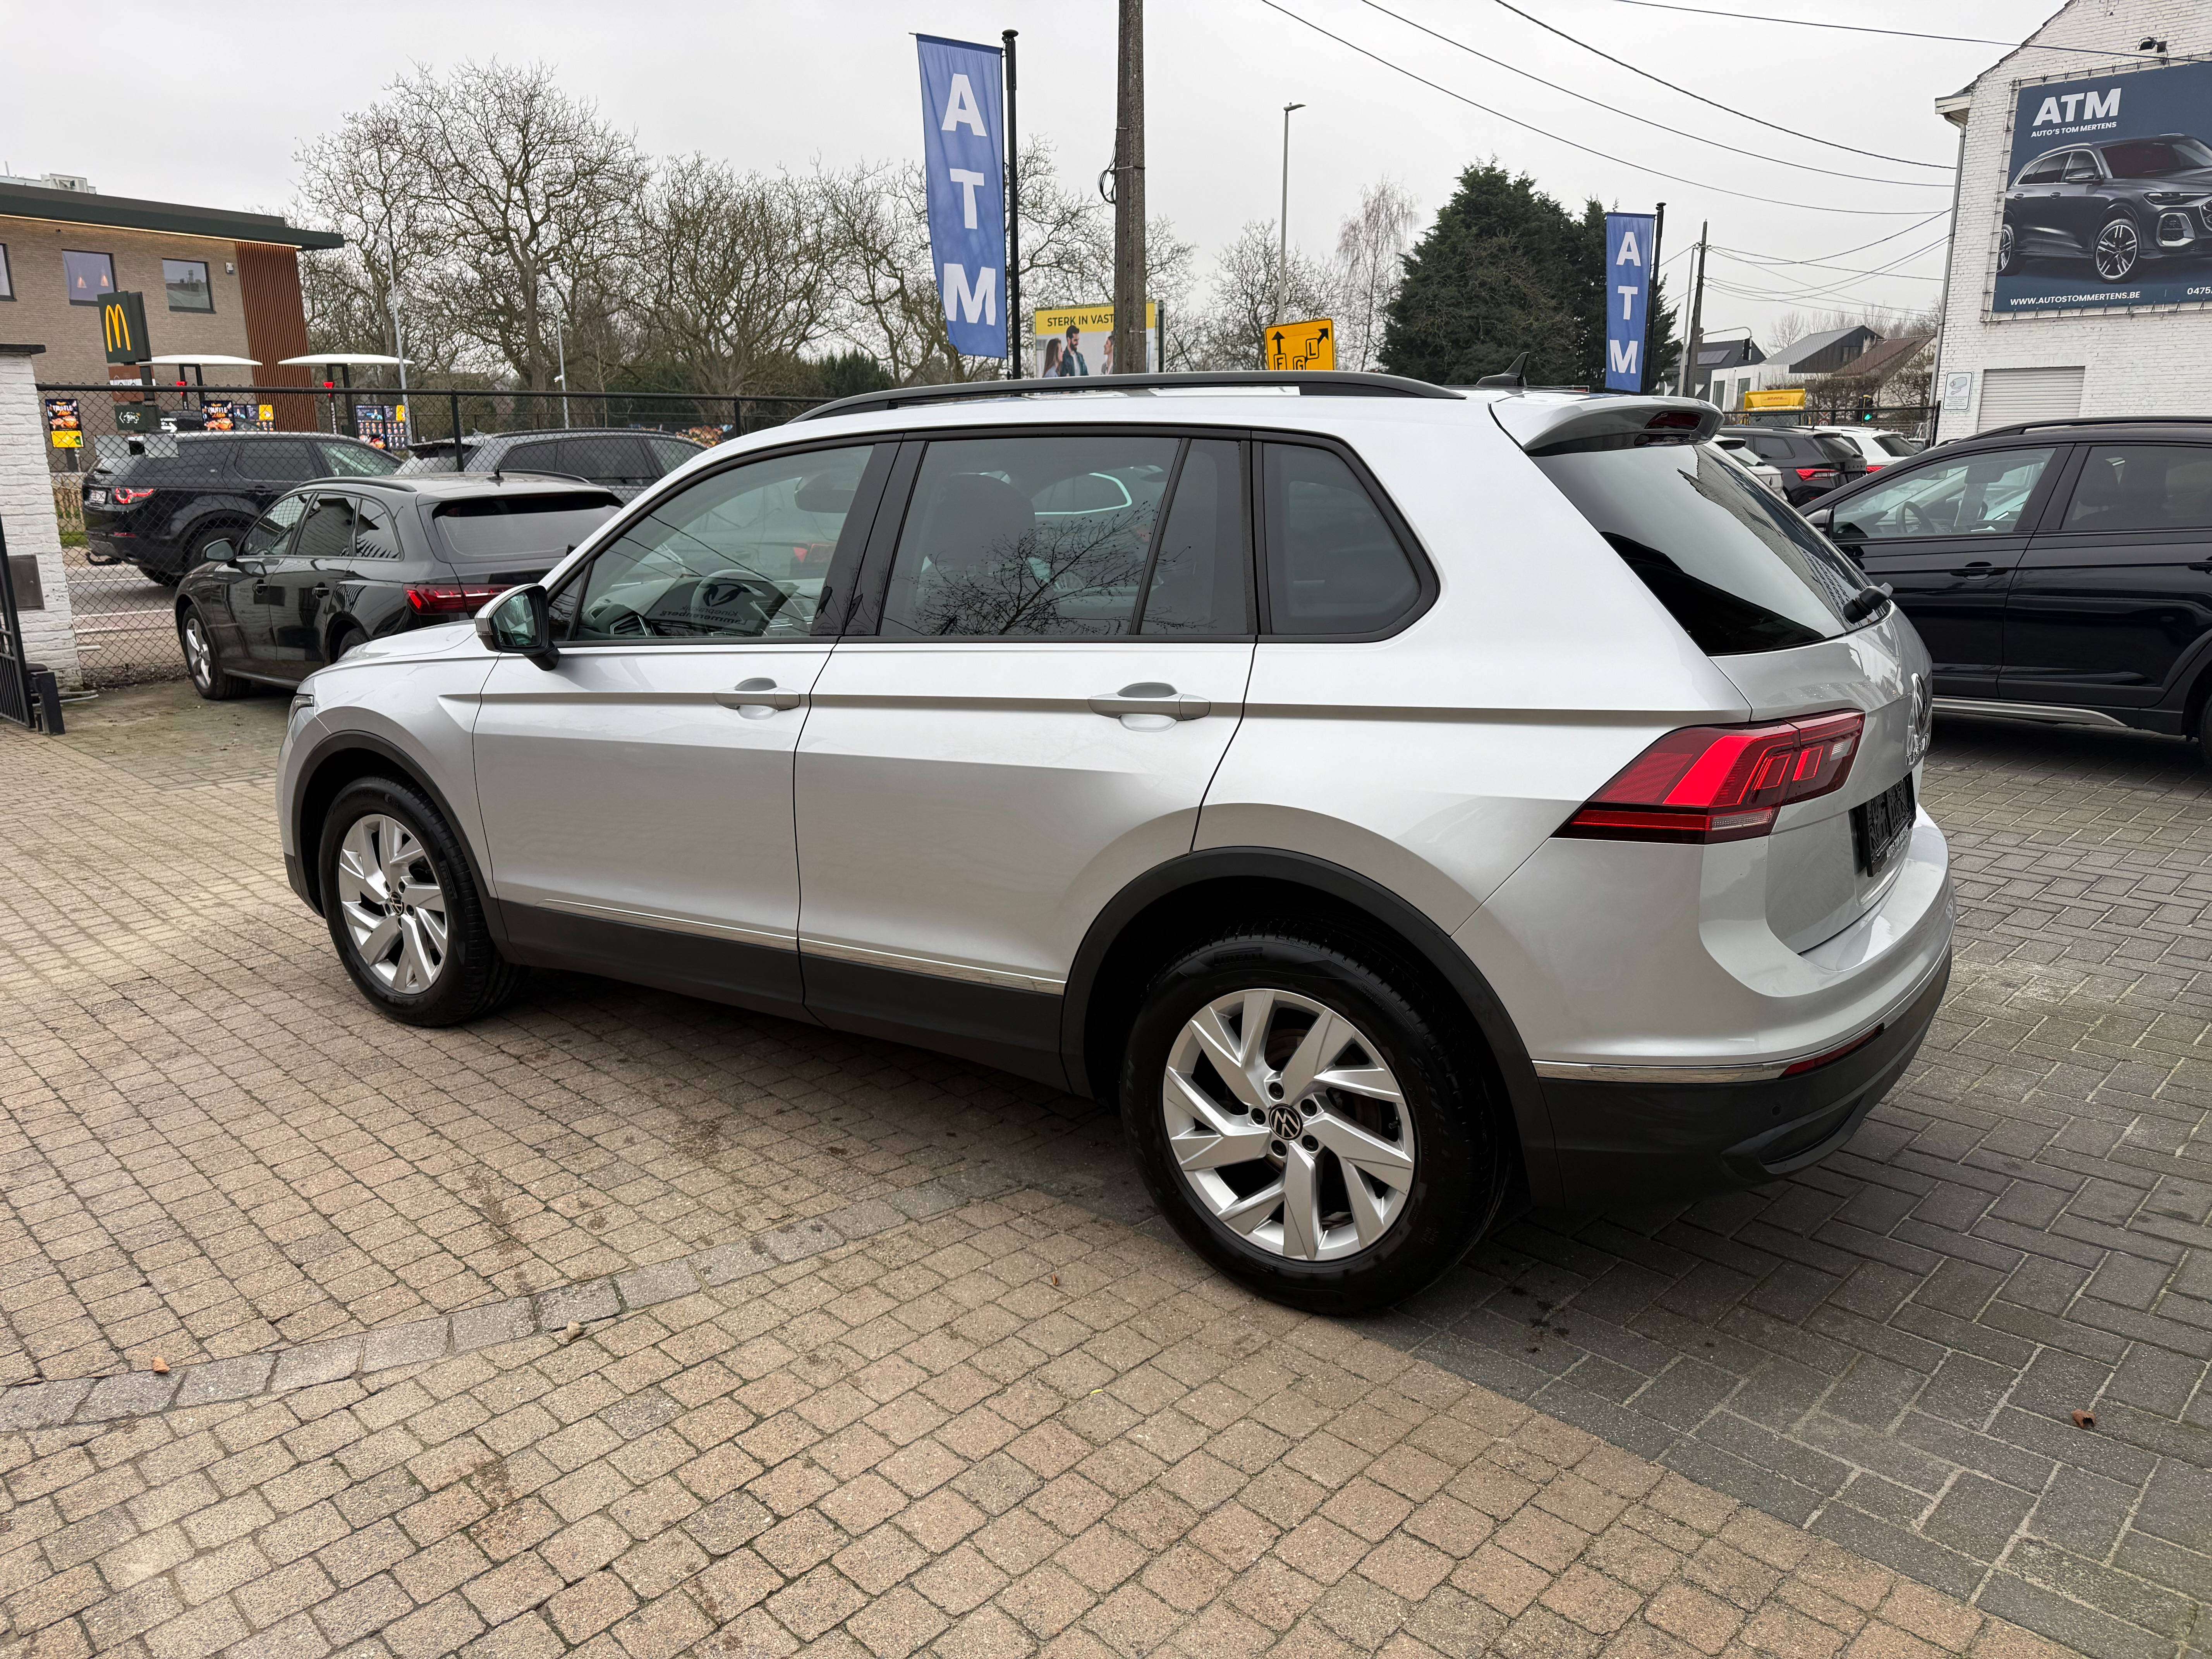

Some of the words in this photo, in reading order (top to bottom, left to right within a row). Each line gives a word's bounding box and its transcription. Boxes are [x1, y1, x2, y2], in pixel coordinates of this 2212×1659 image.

[2032, 88, 2121, 127] ATM
[2031, 128, 2060, 137] AUTO'S
[2061, 125, 2079, 134] TOM
[2080, 121, 2117, 132] MERTENS
[941, 73, 996, 326] ATM
[1609, 231, 1642, 374] ATM
[2010, 291, 2141, 306] WWW.AUTOSTOMMERTENS.BE
[1047, 316, 1075, 327] STERK
[1079, 315, 1088, 325] IN
